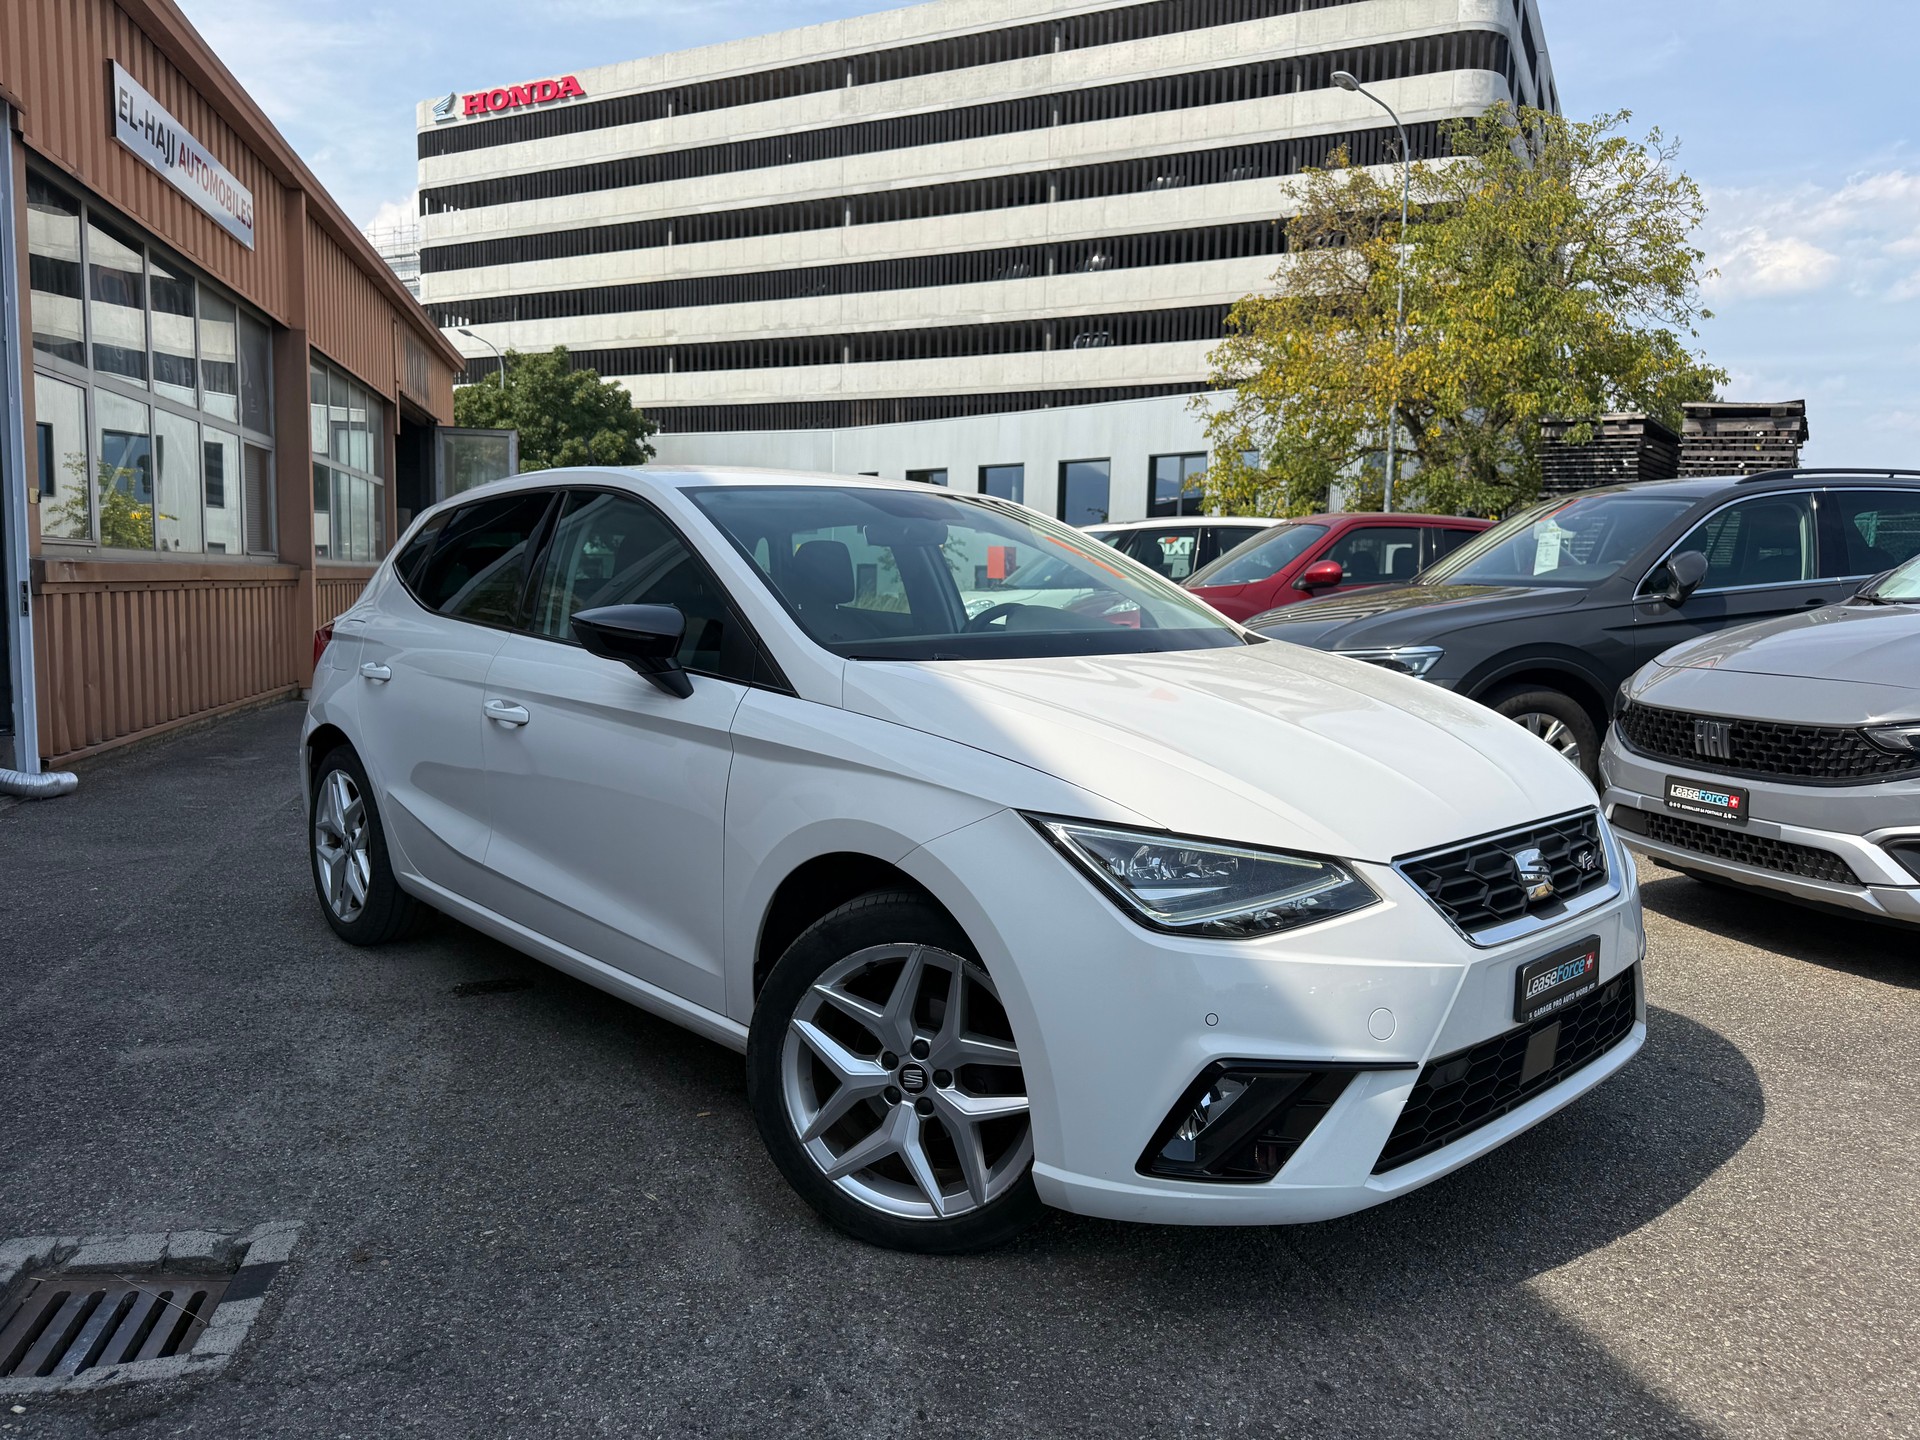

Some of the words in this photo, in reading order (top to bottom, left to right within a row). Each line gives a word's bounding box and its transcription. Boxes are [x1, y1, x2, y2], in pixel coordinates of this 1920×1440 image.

[462, 75, 585, 115] HONDA
[118, 86, 176, 169] EL-HAJJ
[178, 142, 253, 230] AUTOMOBILES
[1694, 719, 1732, 759] FIAT
[1670, 783, 1729, 804] LeaseForce
[1526, 958, 1586, 998] LeaseForce
[1533, 1002, 1552, 1018] GARAGE
[1552, 998, 1562, 1009] PRO
[1563, 992, 1576, 1004] AUTO
